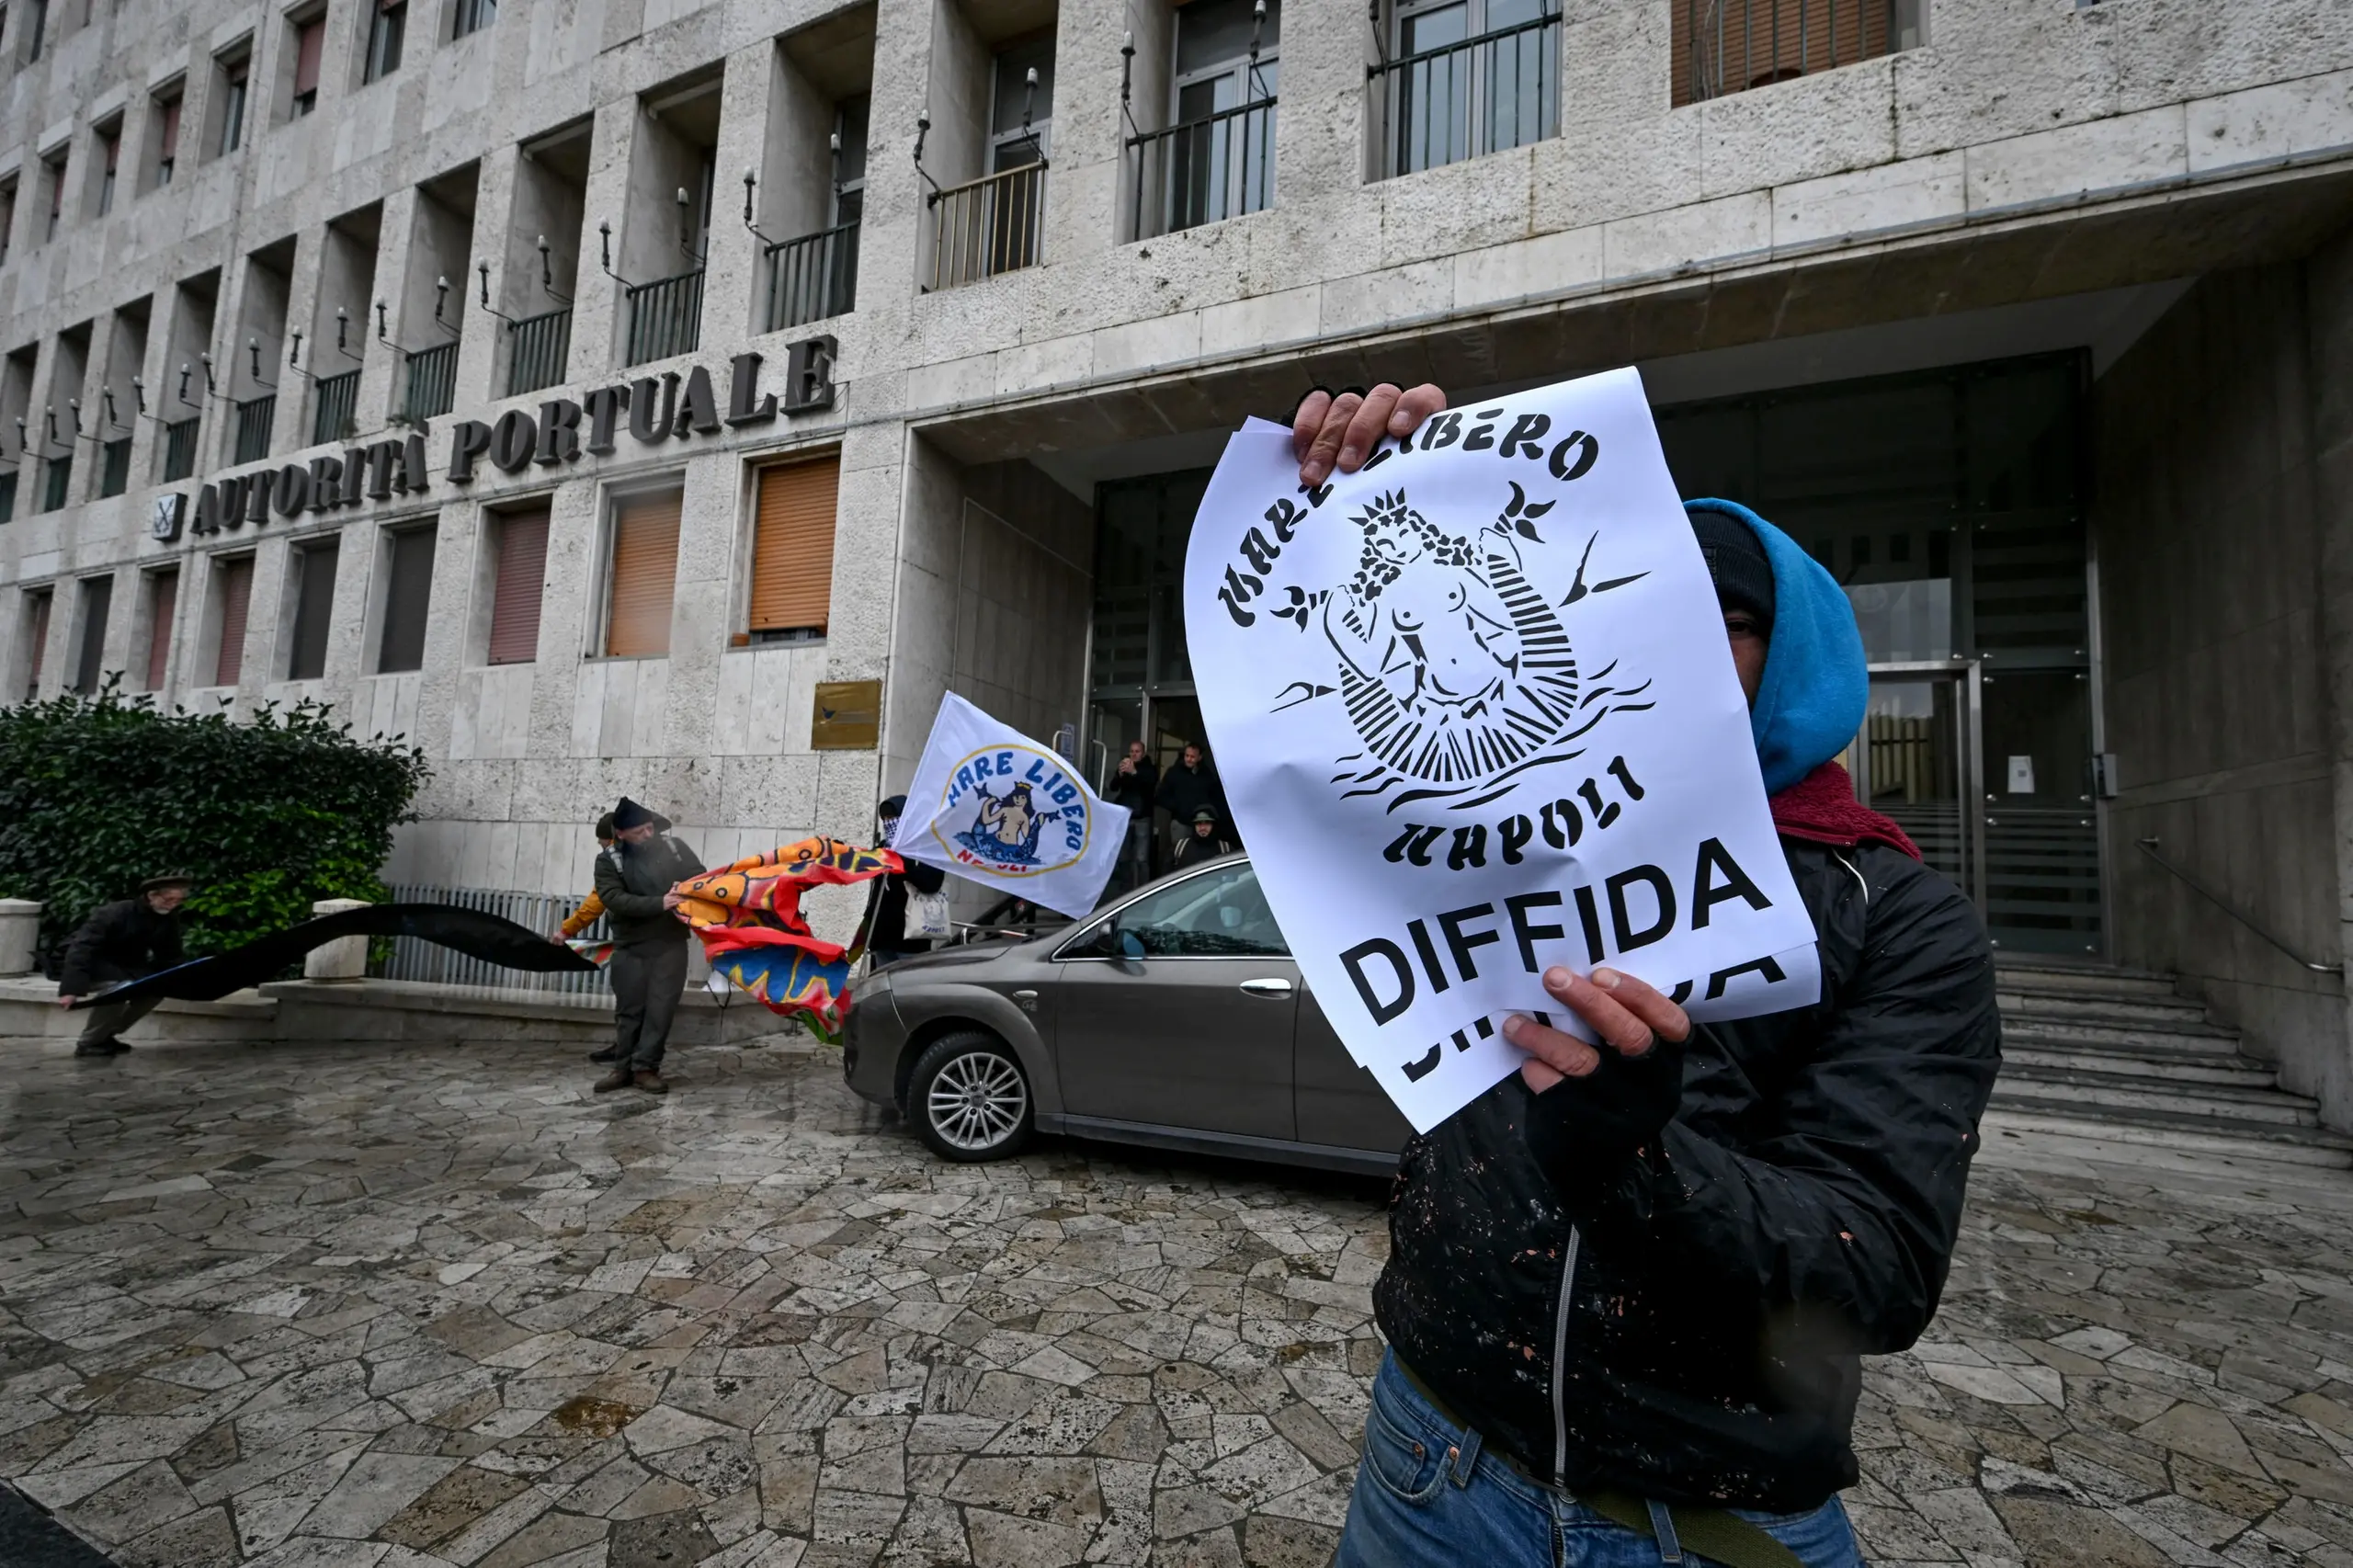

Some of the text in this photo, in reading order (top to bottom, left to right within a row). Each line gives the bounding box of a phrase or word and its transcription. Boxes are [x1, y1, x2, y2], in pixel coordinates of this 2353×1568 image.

[446, 334, 839, 485] PORTUALE
[948, 751, 1086, 851] MARE LIBERO
[1381, 756, 1645, 872] NAPOLI
[1339, 836, 1774, 1027] DIFFIDA
